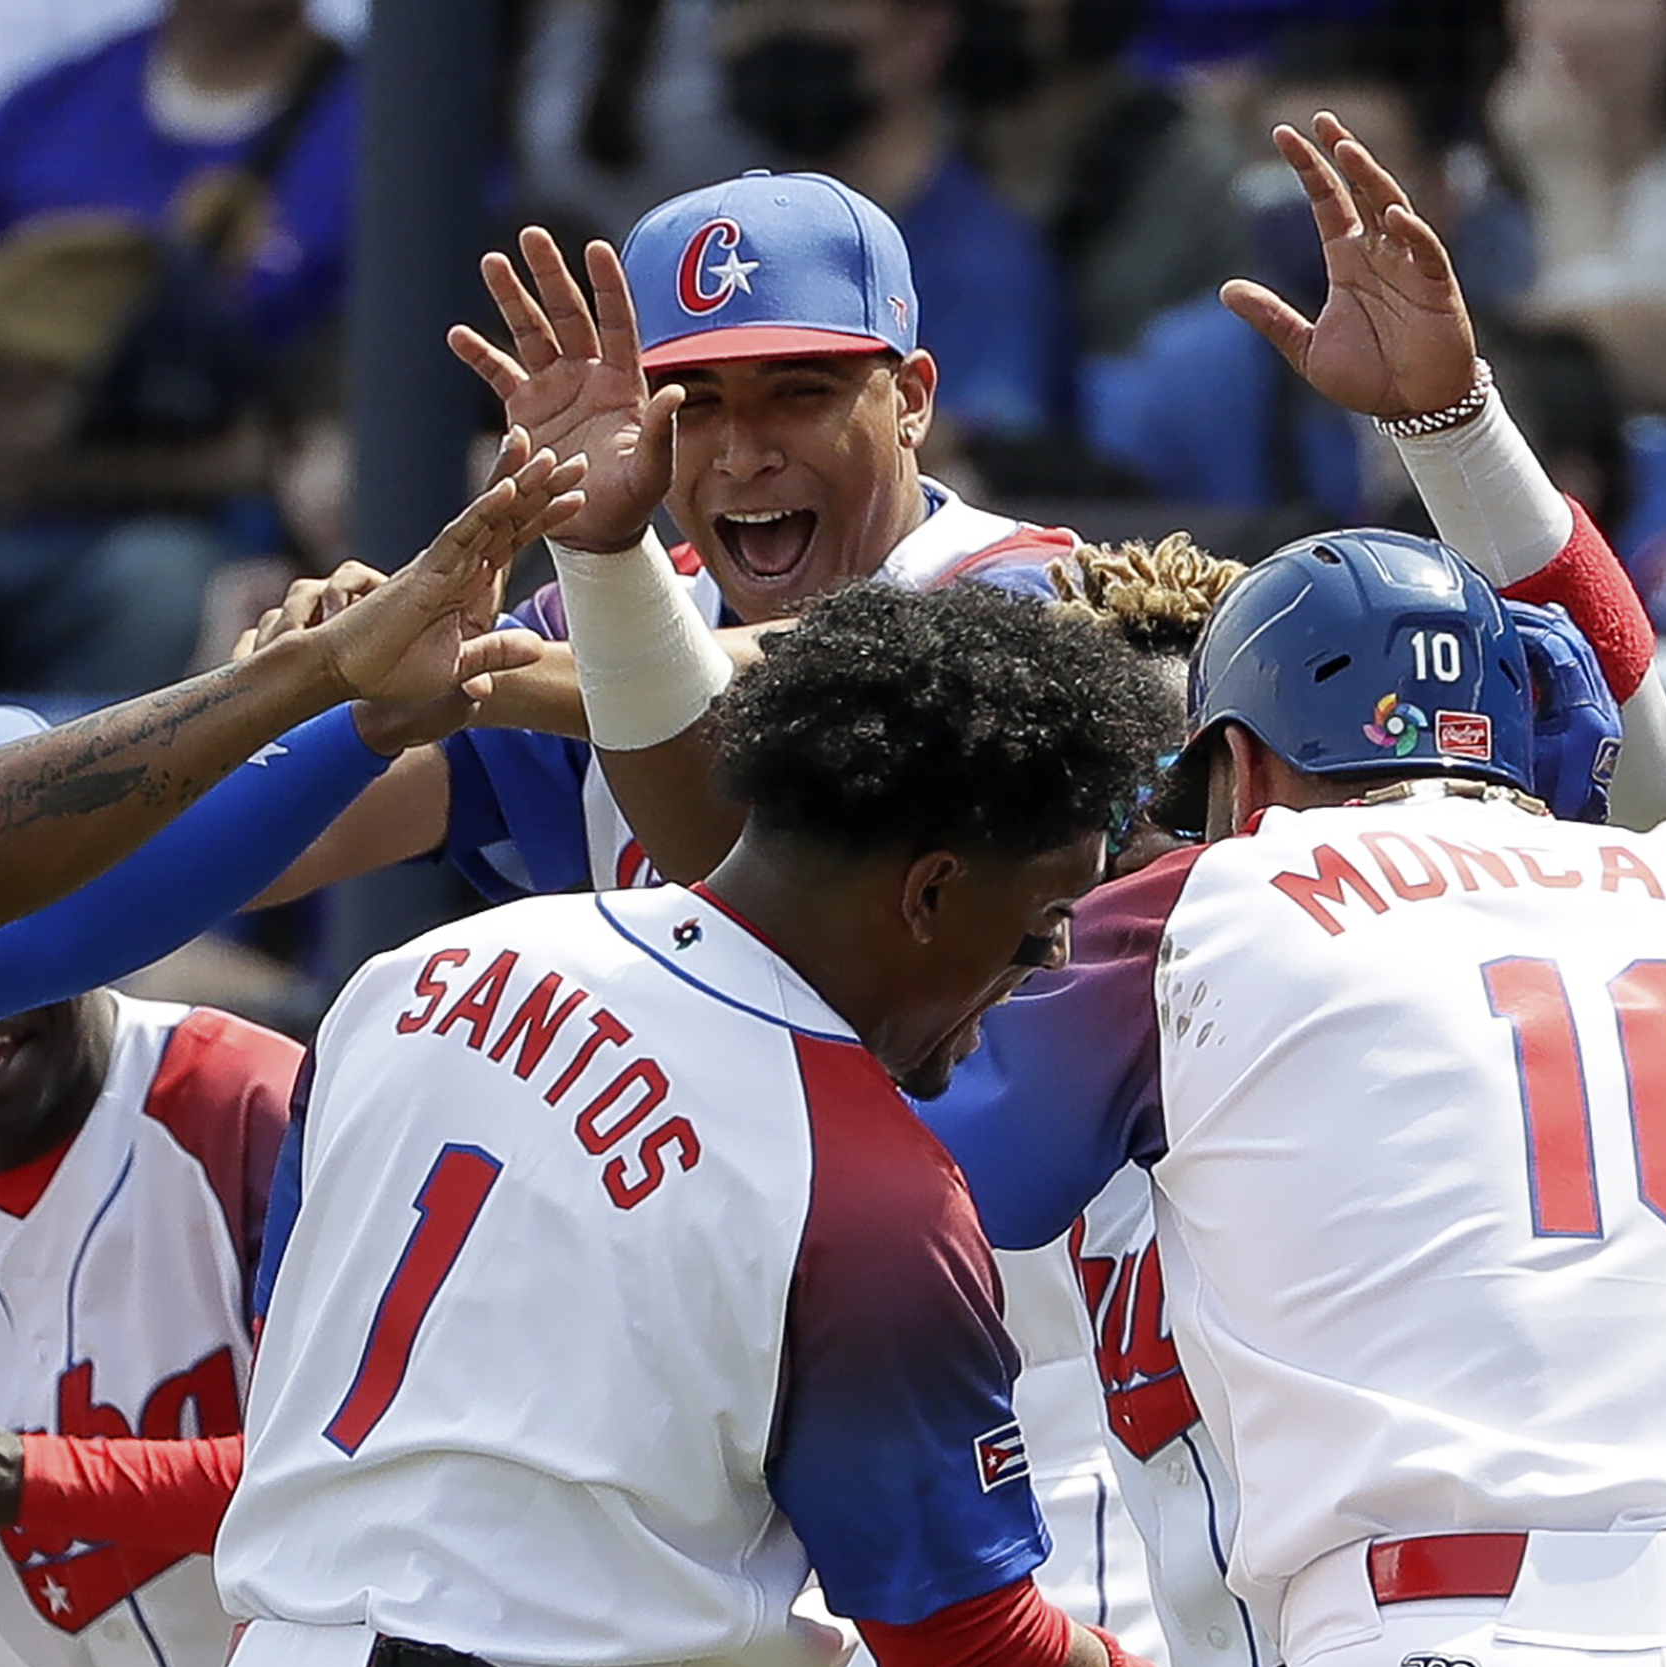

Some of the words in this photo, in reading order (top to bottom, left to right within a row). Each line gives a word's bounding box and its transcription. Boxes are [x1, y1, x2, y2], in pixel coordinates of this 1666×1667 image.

[677, 216, 742, 316] C
[1411, 631, 1461, 682] 10
[396, 948, 701, 1211] SANTOS
[323, 1142, 503, 1460] 1
